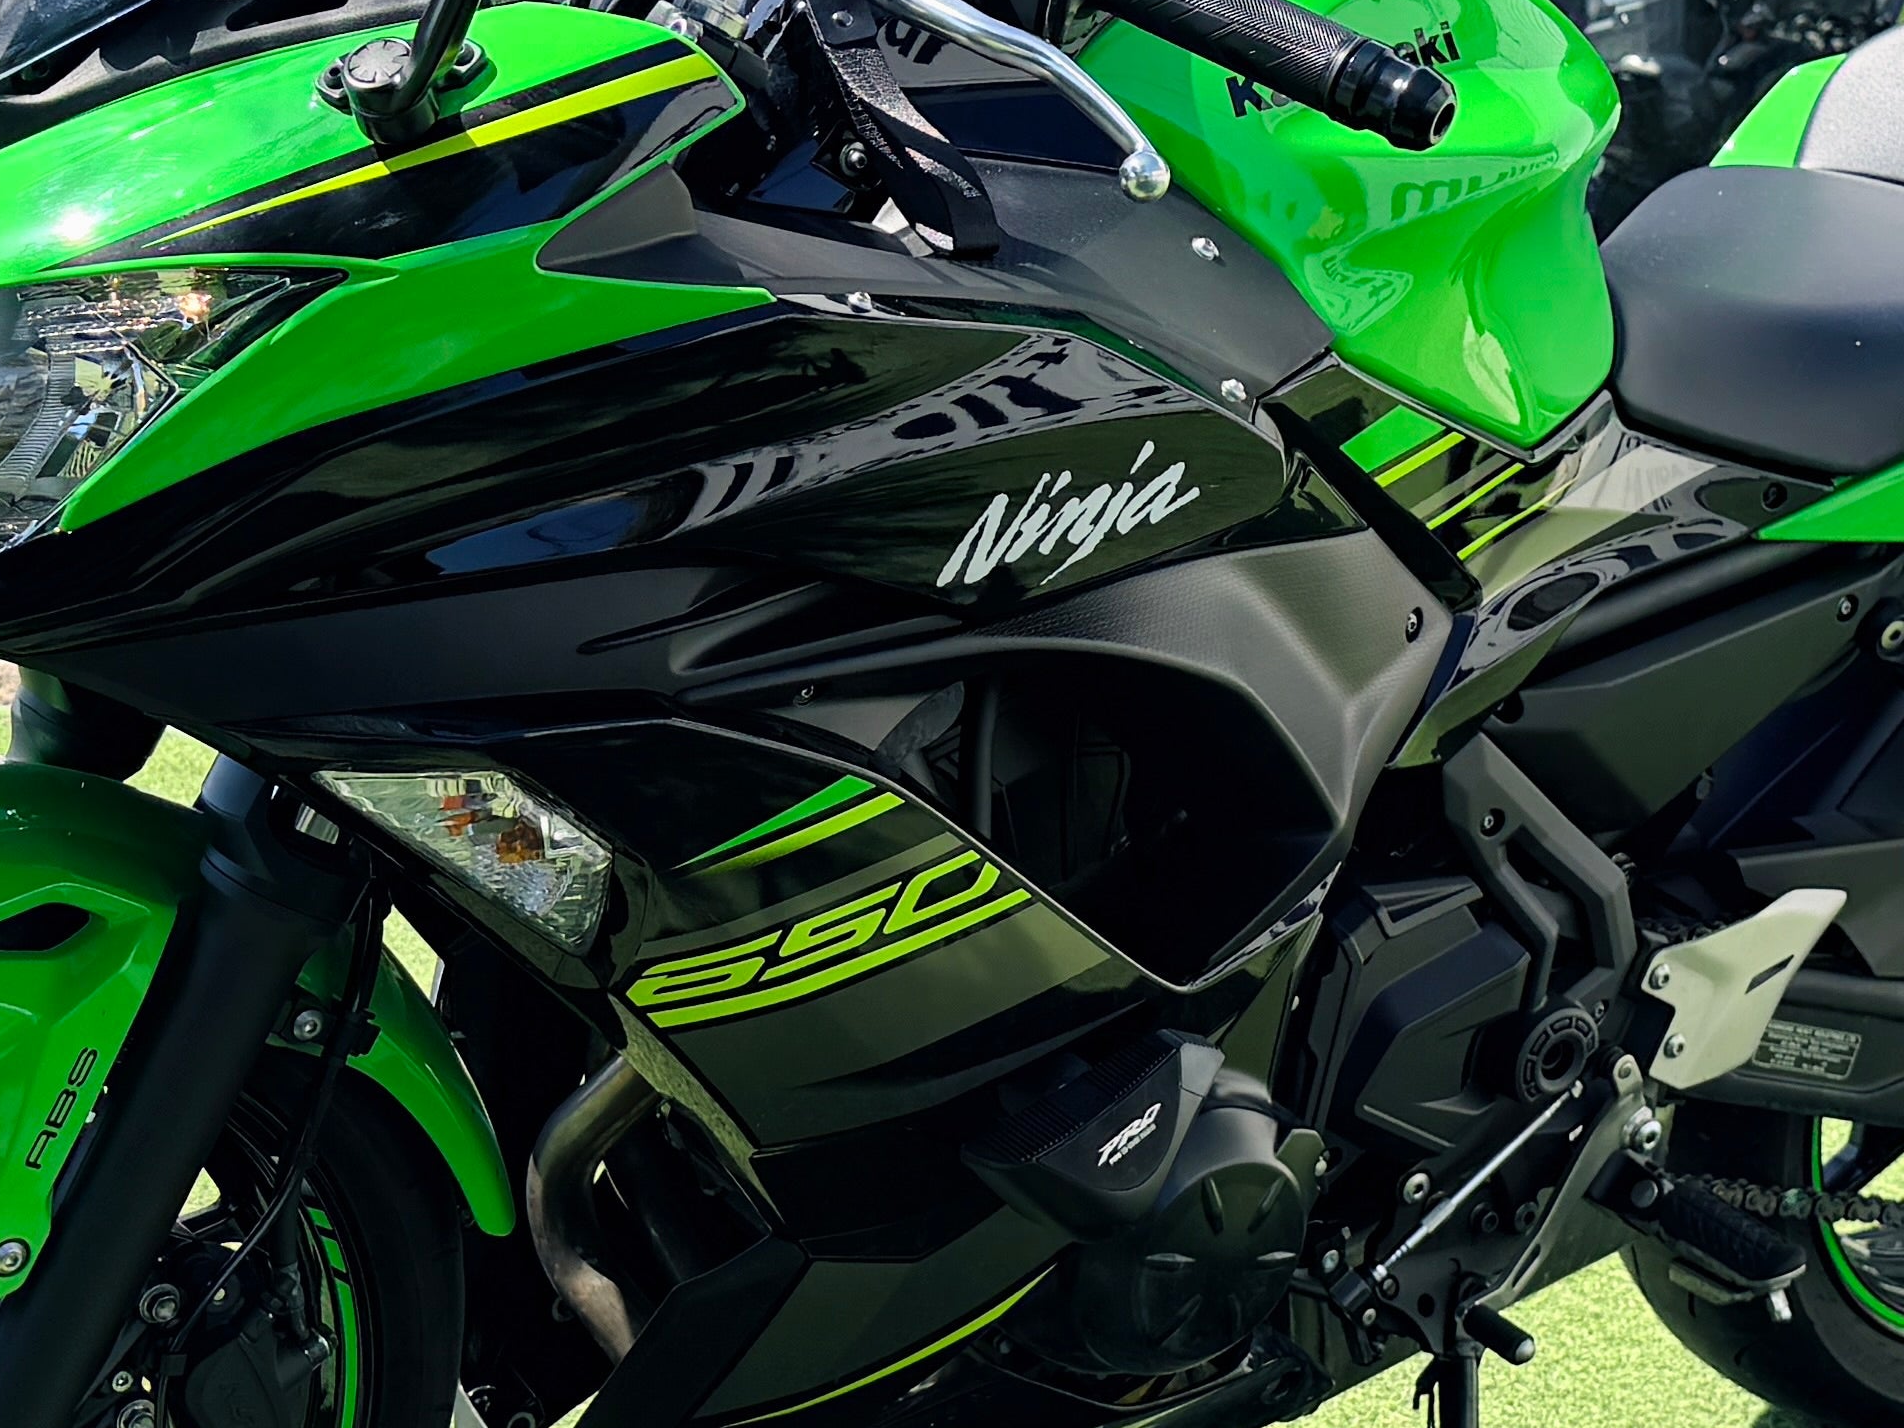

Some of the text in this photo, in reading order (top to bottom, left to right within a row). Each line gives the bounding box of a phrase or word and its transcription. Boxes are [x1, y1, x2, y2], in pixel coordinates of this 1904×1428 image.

[936, 440, 1200, 586] Ninja
[626, 849, 1000, 1007] 650
[25, 1046, 98, 1171] ABS
[1097, 1102, 1162, 1167] PRO
